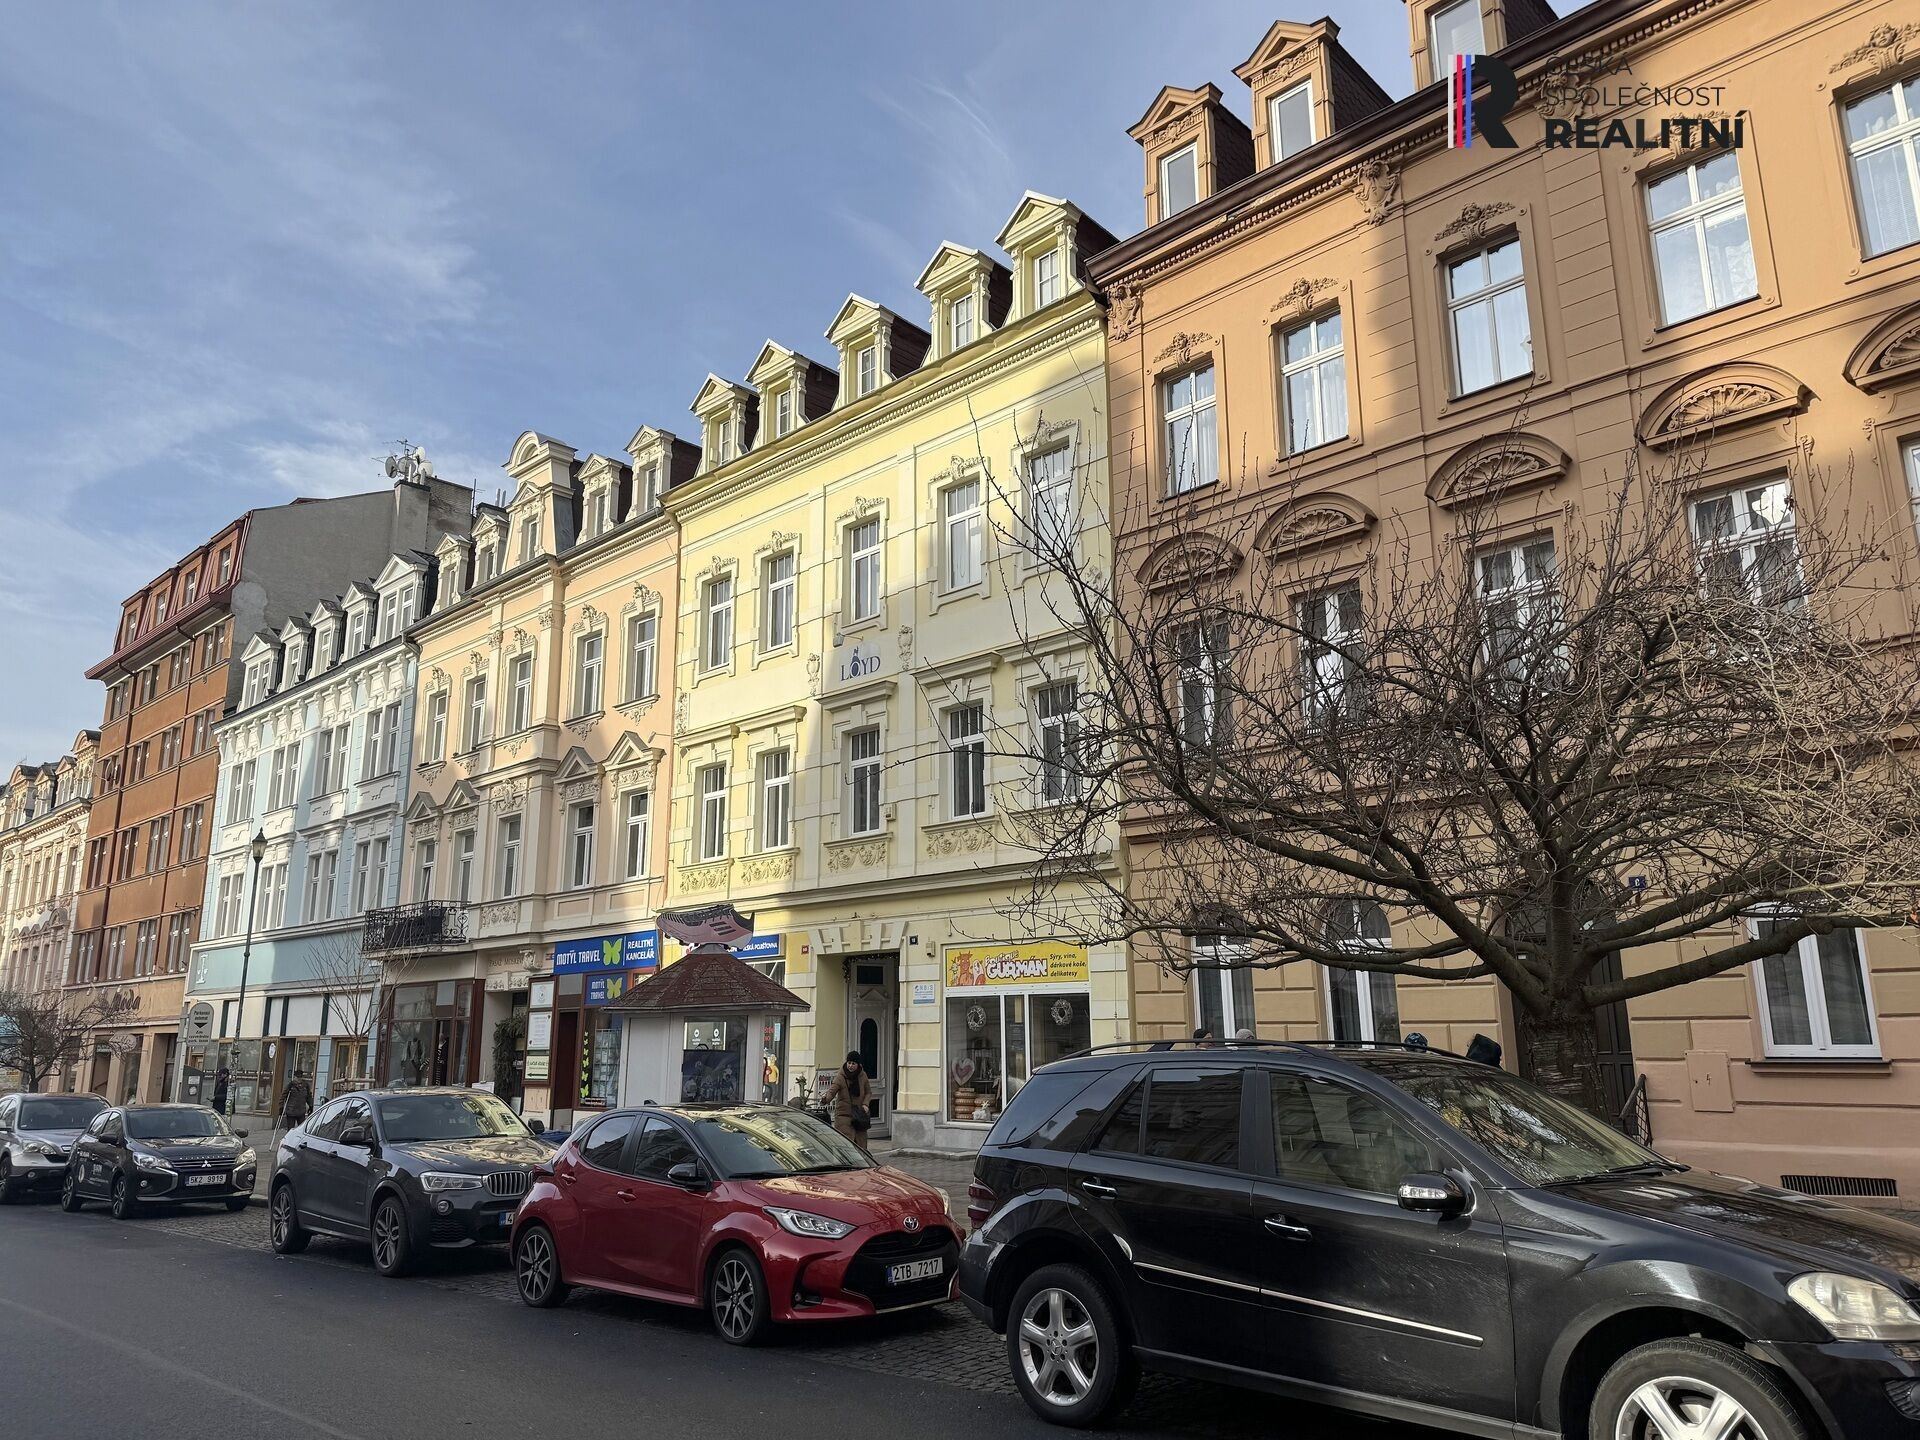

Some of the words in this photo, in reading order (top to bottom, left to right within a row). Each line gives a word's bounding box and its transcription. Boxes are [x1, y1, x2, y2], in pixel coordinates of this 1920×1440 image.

[841, 655, 881, 681] LOYD
[627, 936, 654, 949] REALITNÍ
[556, 949, 577, 966] MOTÝL
[578, 949, 601, 963] TRAVEL
[626, 948, 655, 962] KANCELÁŘ
[986, 956, 1048, 981] GURMÁN
[207, 1174, 224, 1183] 9919
[893, 1264, 912, 1280] 2TB
[918, 1259, 939, 1277] 7217
